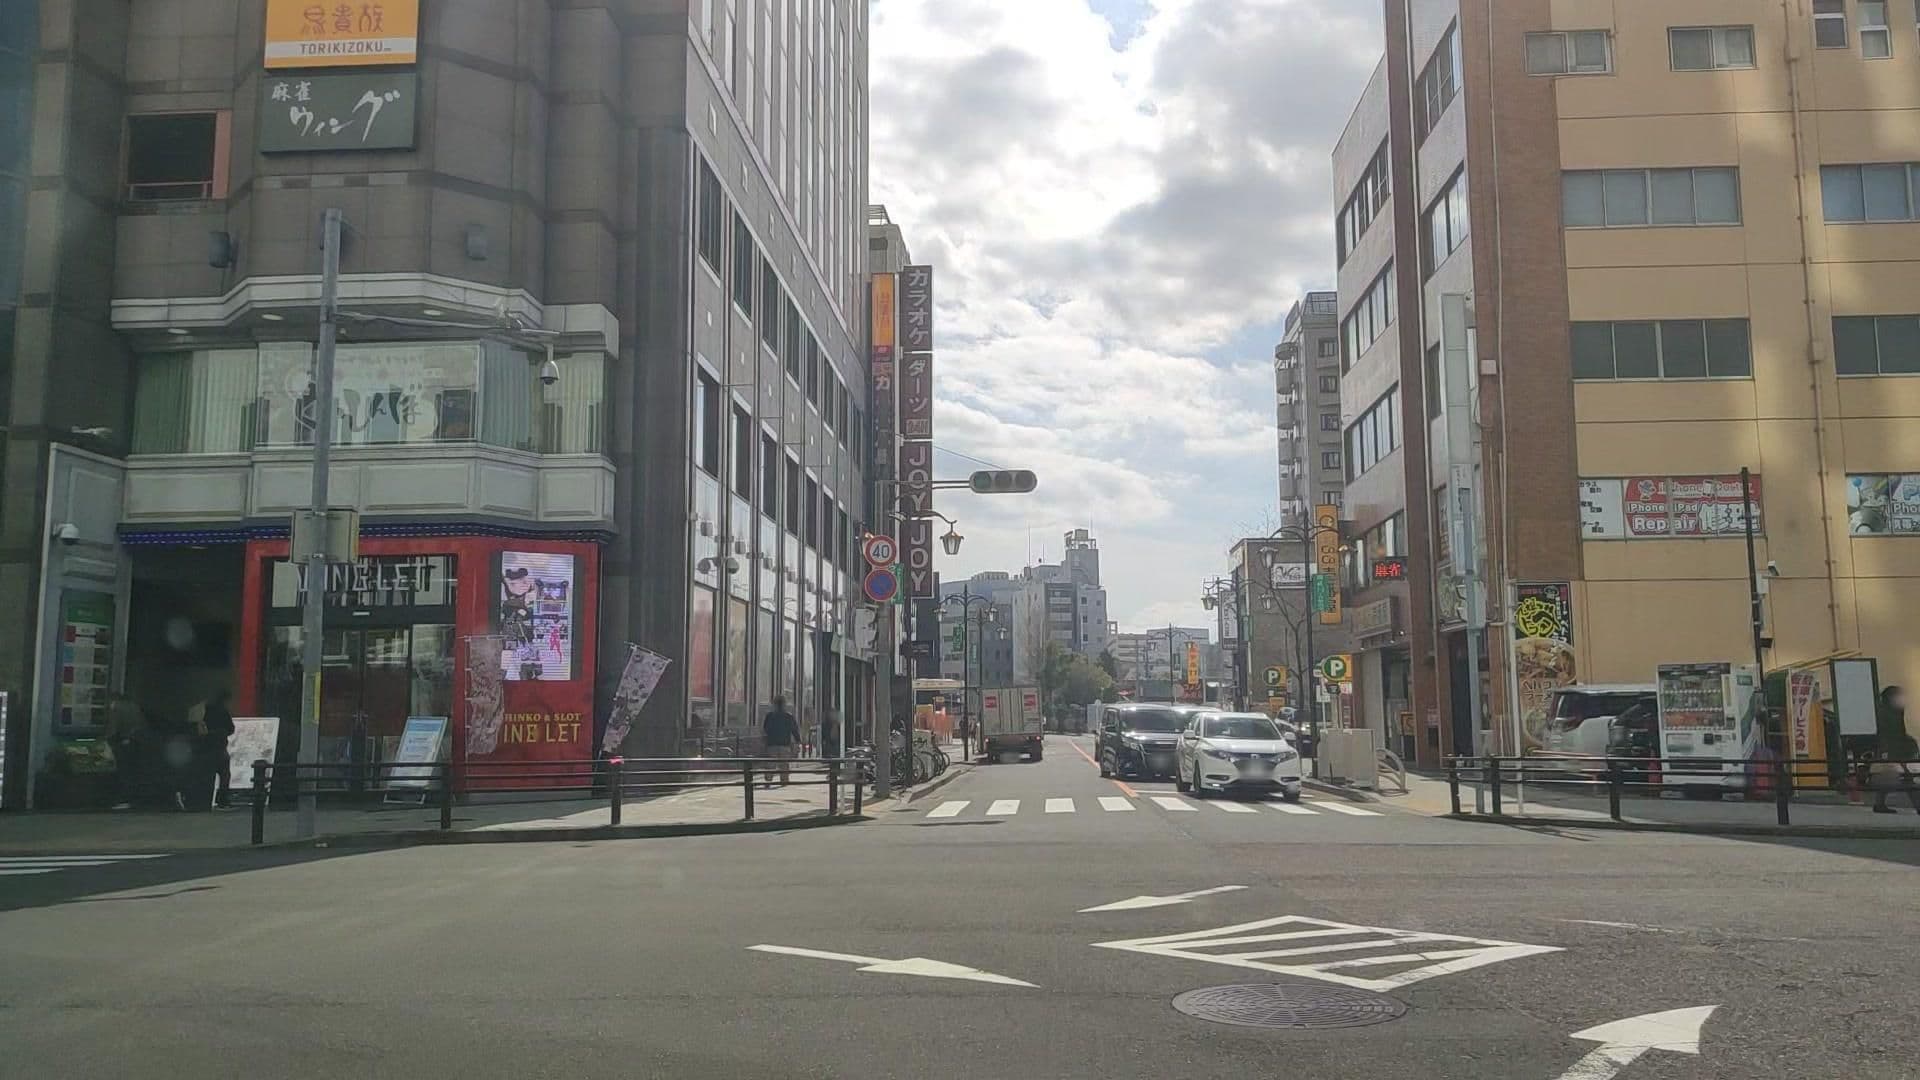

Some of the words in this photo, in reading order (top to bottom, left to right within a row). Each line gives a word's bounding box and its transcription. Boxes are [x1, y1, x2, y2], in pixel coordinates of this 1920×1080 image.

[300, 41, 383, 55] TORIKIZOKU
[271, 80, 312, 103] 麻雀
[289, 89, 401, 144] ウィング
[908, 269, 929, 346] カラオケ
[908, 359, 928, 413] ダーツ
[872, 544, 890, 559] 40
[1267, 670, 1279, 684] P
[1330, 659, 1344, 677] P
